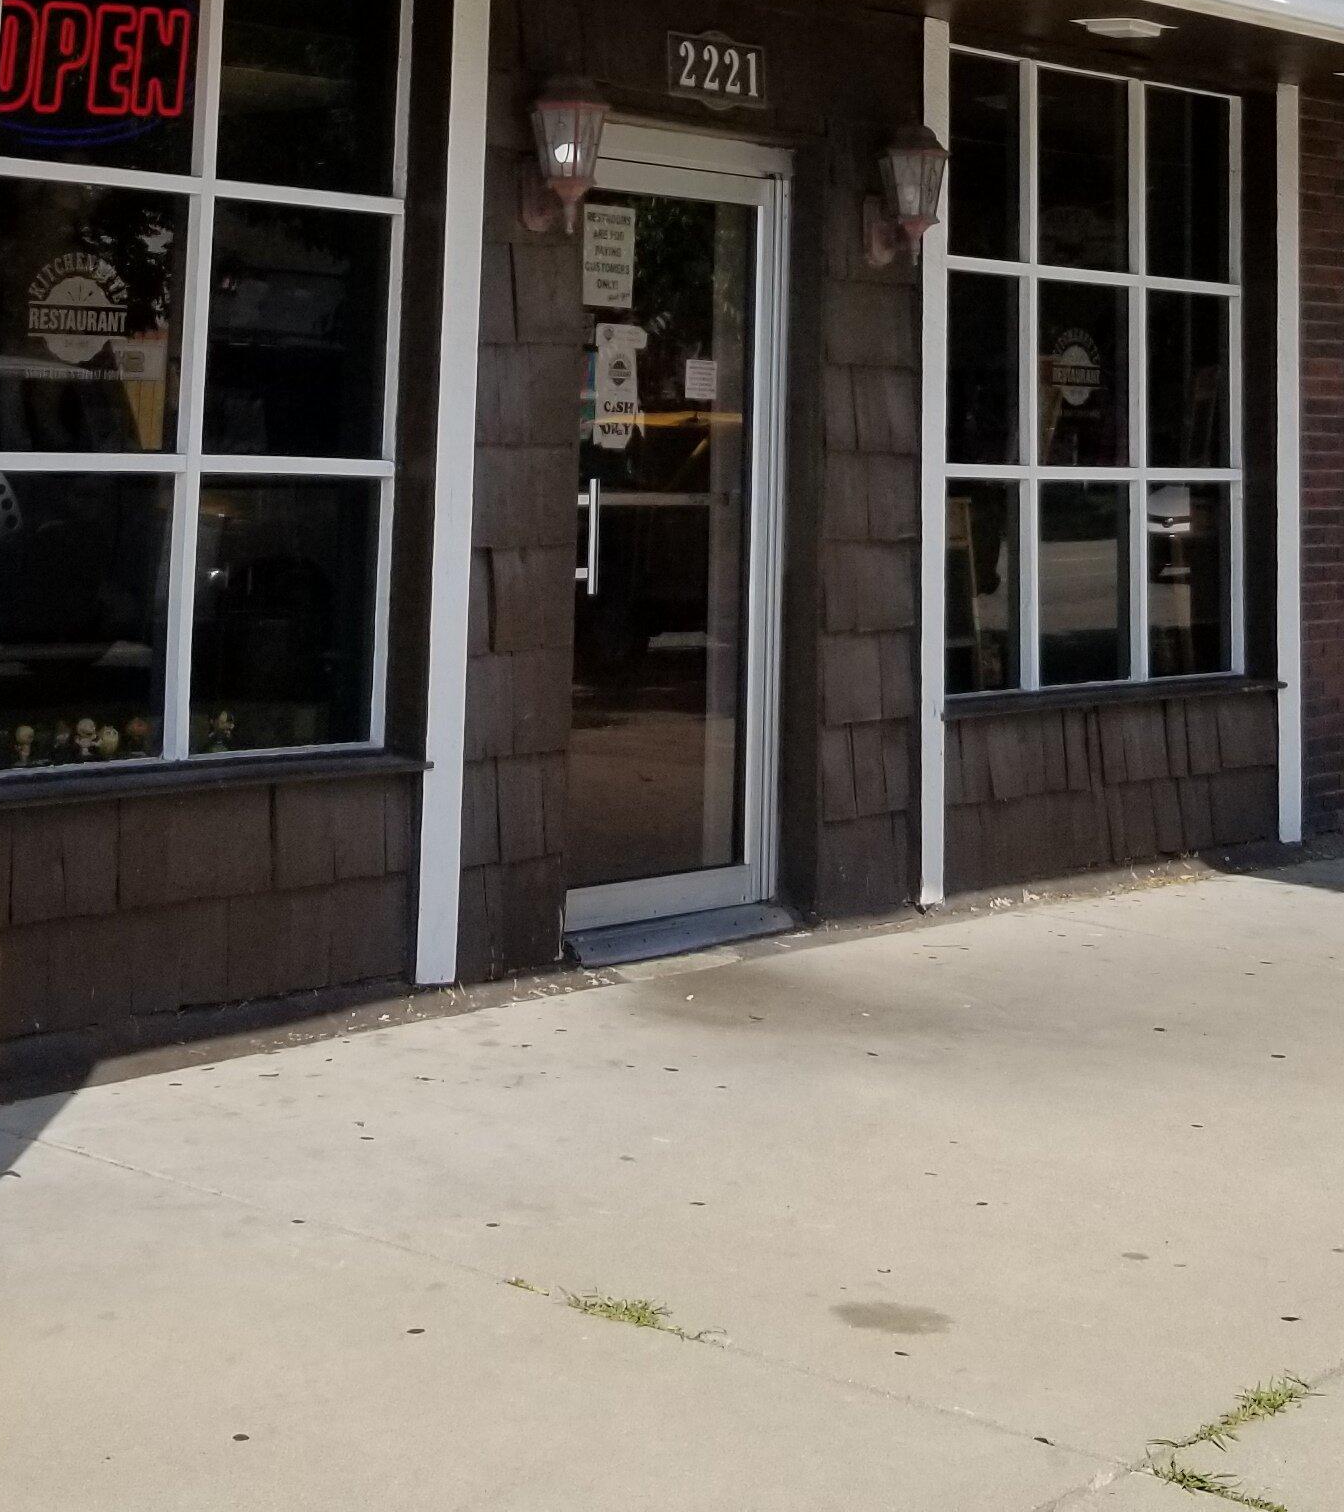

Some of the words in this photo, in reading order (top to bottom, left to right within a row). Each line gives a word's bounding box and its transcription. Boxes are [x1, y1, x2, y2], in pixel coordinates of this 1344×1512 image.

[679, 40, 759, 97] 2221
[28, 307, 127, 333] RESTAURANT
[604, 400, 634, 414] CASH
